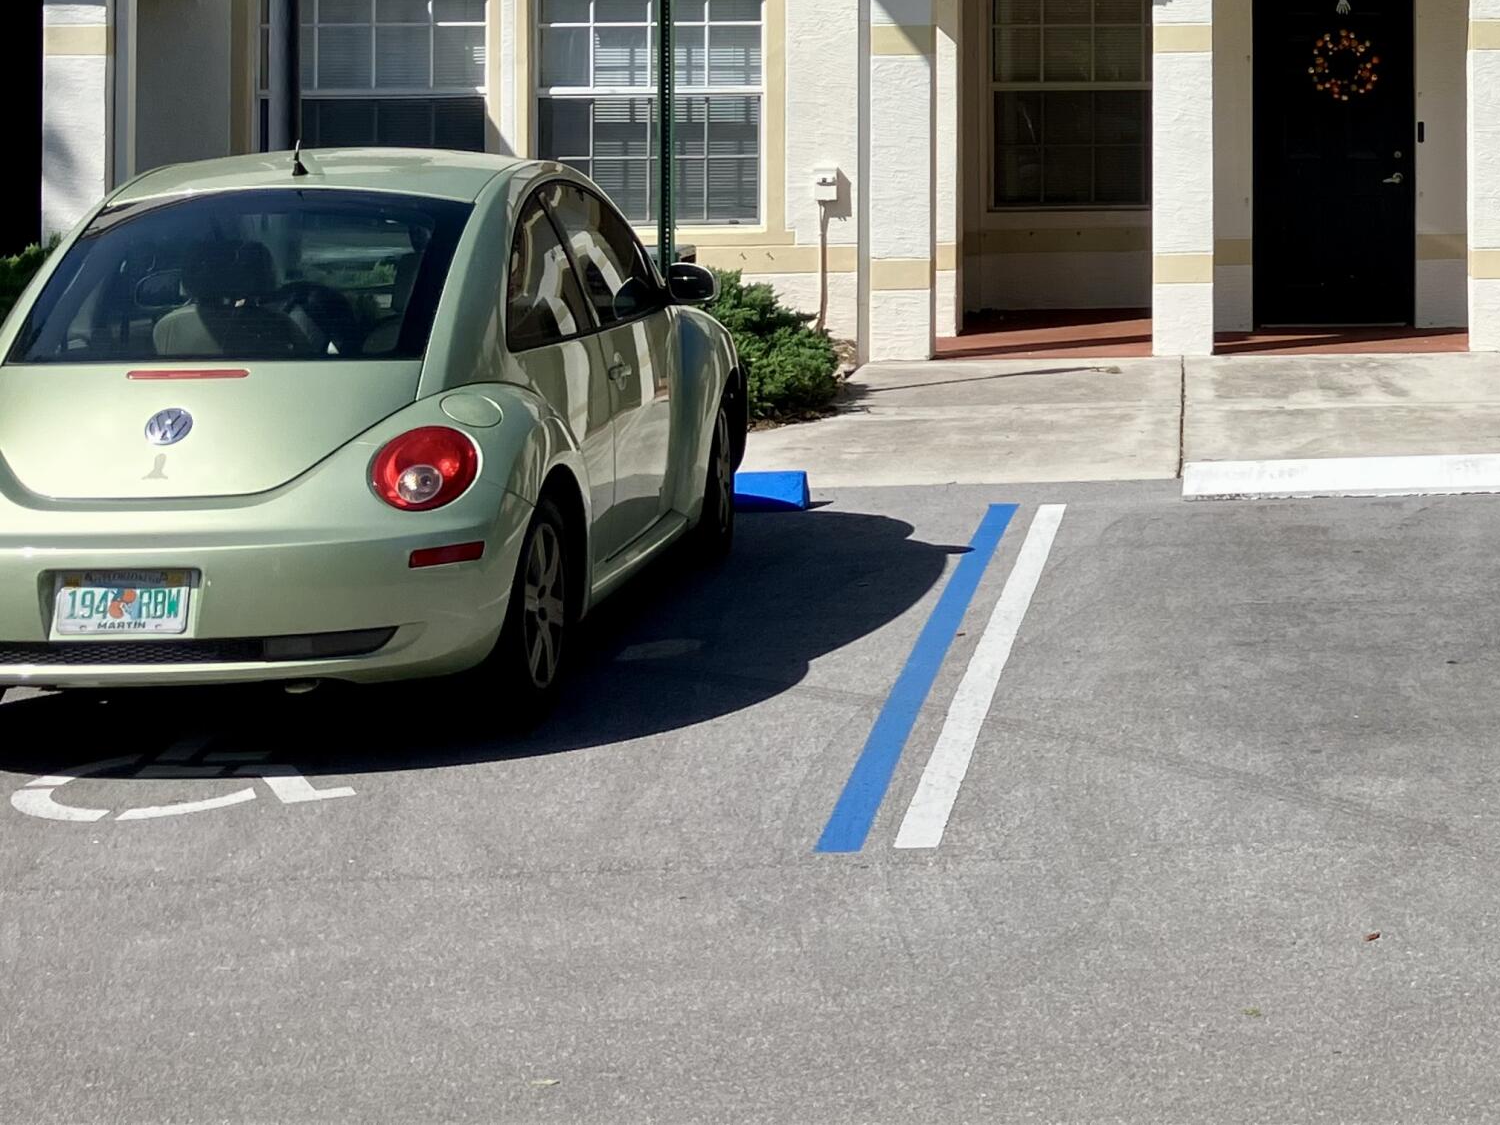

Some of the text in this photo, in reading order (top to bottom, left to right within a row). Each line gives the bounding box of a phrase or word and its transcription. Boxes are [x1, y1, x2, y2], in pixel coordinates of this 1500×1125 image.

[66, 588, 181, 620] 194 RBW
[97, 621, 146, 630] MARTIN
